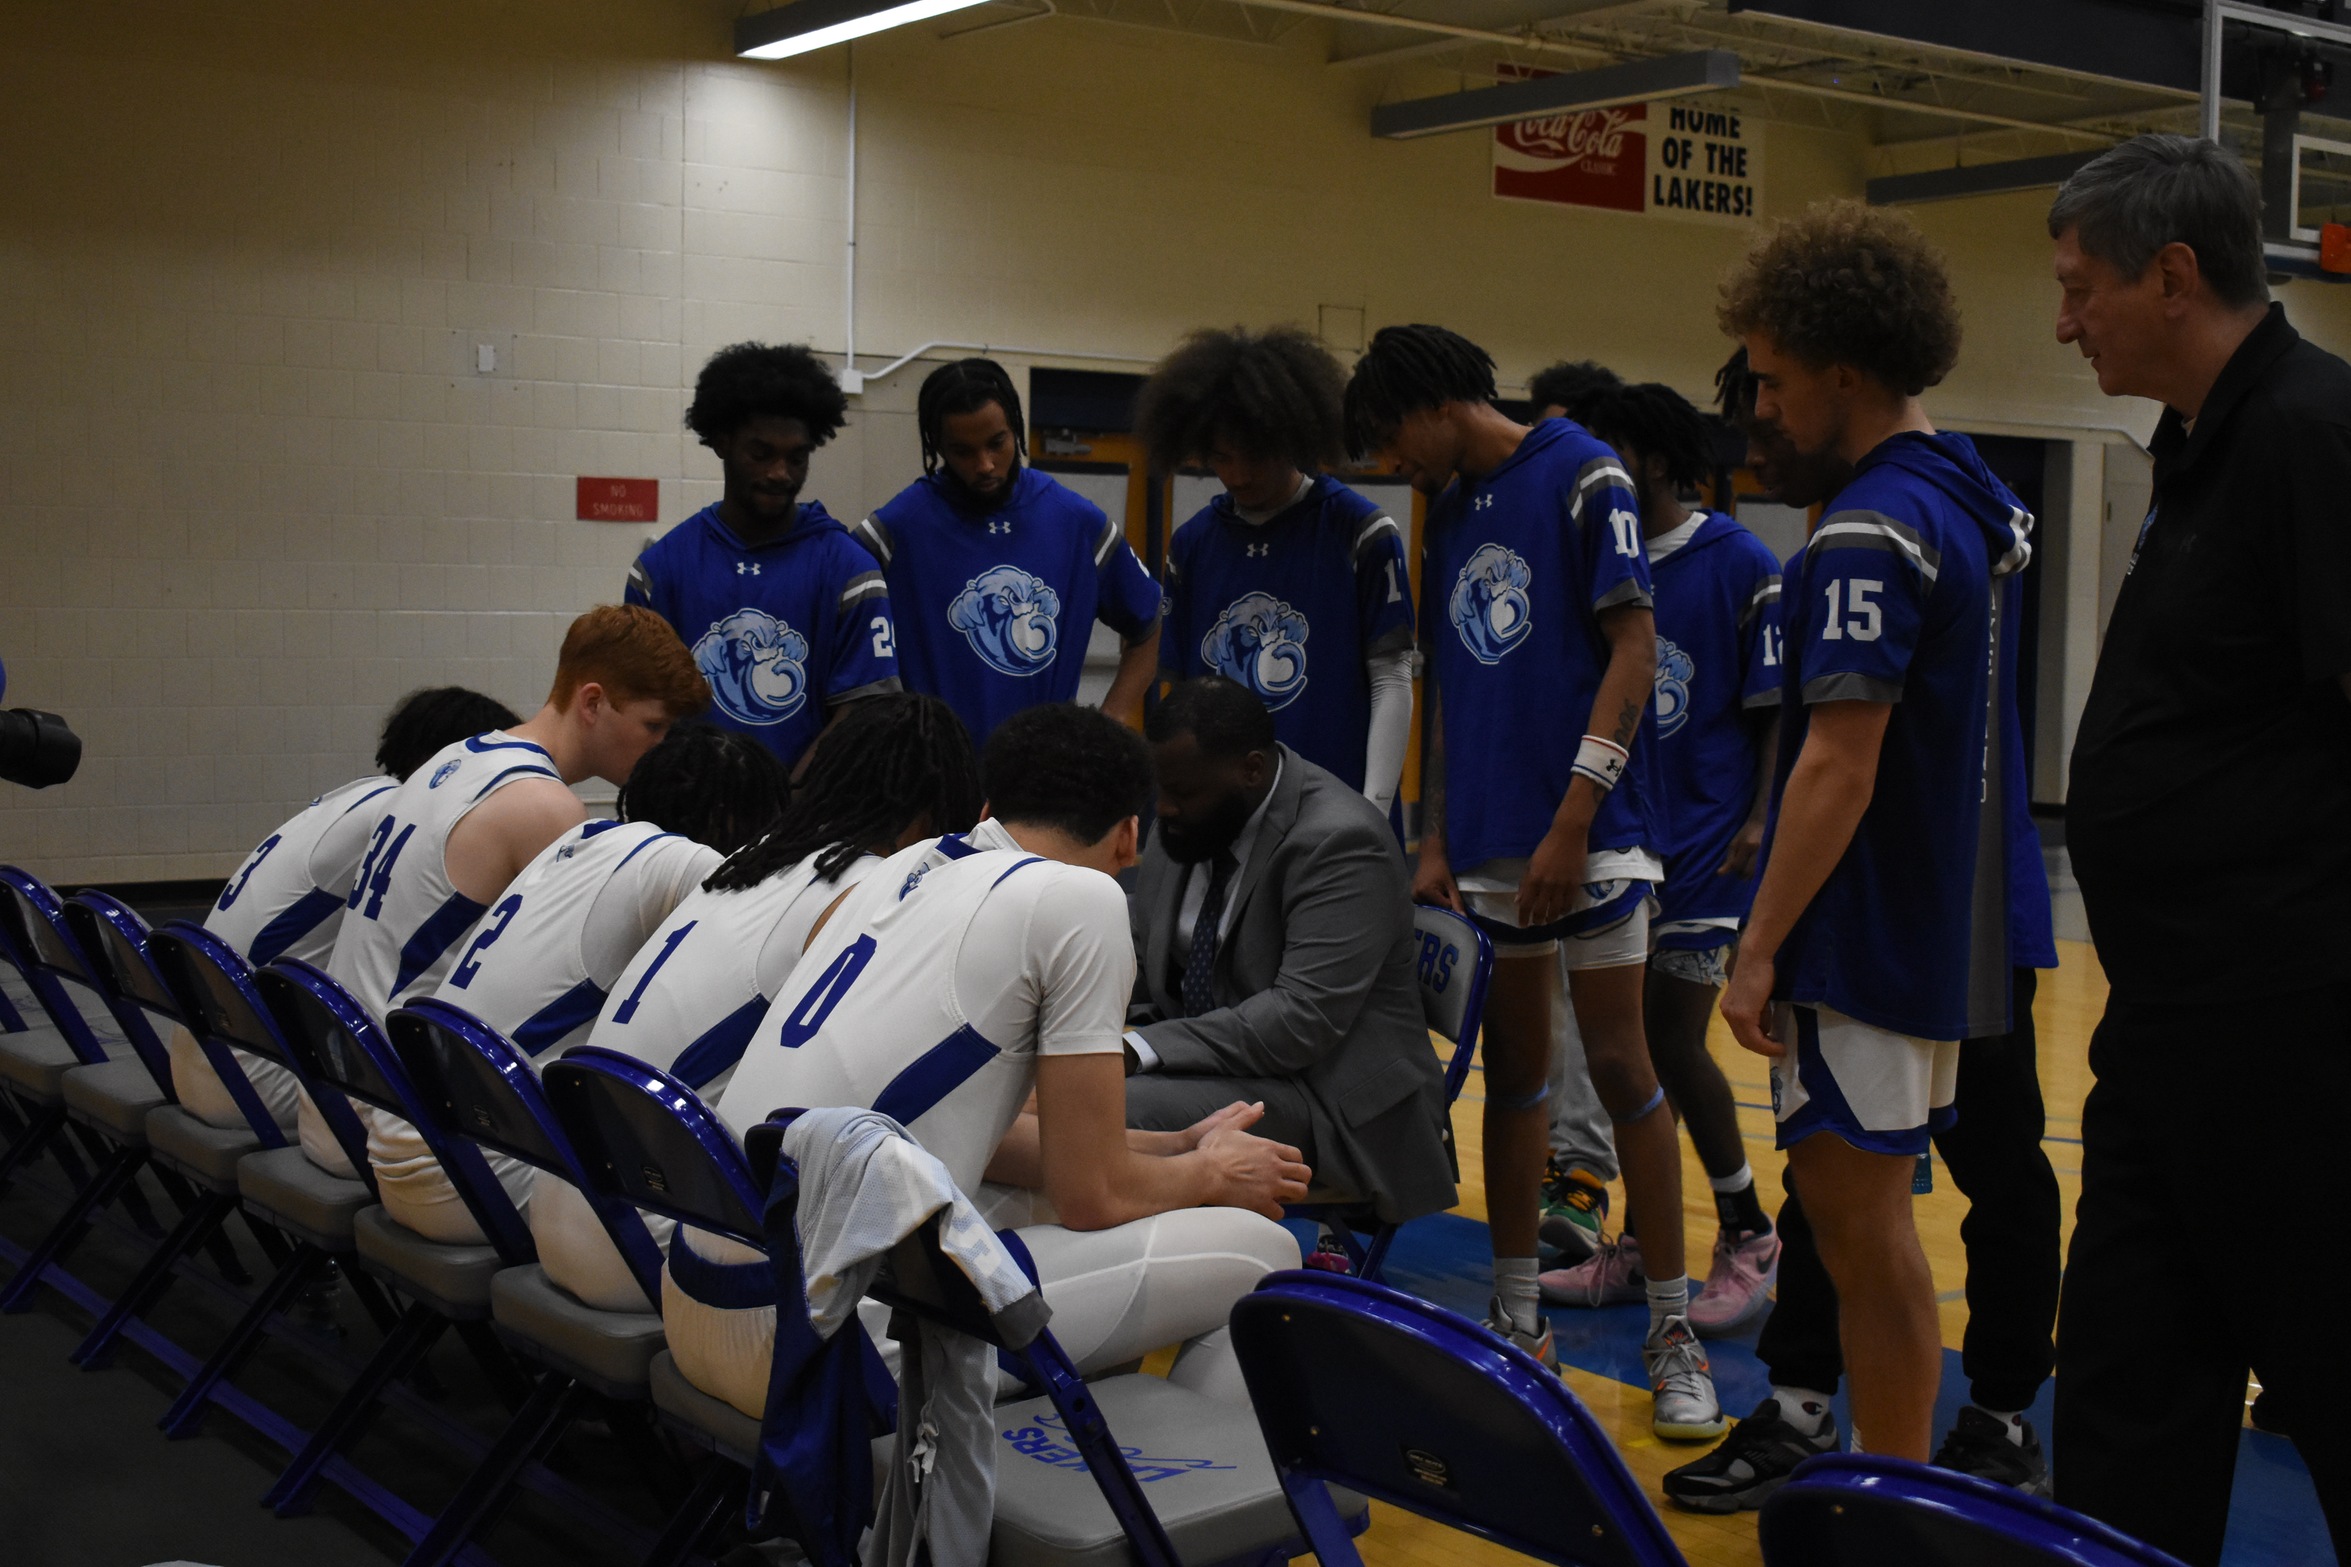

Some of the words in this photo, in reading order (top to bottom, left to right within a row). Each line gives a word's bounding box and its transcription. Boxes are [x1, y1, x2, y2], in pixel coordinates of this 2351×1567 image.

[1671, 107, 1740, 138] HOME
[1663, 137, 1692, 170] OF
[1706, 142, 1747, 178] THE
[1654, 174, 1753, 217] LAKERS!
[592, 502, 645, 517] SMOKING
[610, 484, 627, 498] NO
[1608, 507, 1640, 559] 10
[1822, 578, 1884, 642] 15
[217, 833, 283, 912] 3
[347, 814, 417, 921] 34
[448, 893, 524, 990] 2
[611, 919, 699, 1024] 1
[780, 932, 878, 1049] 0
